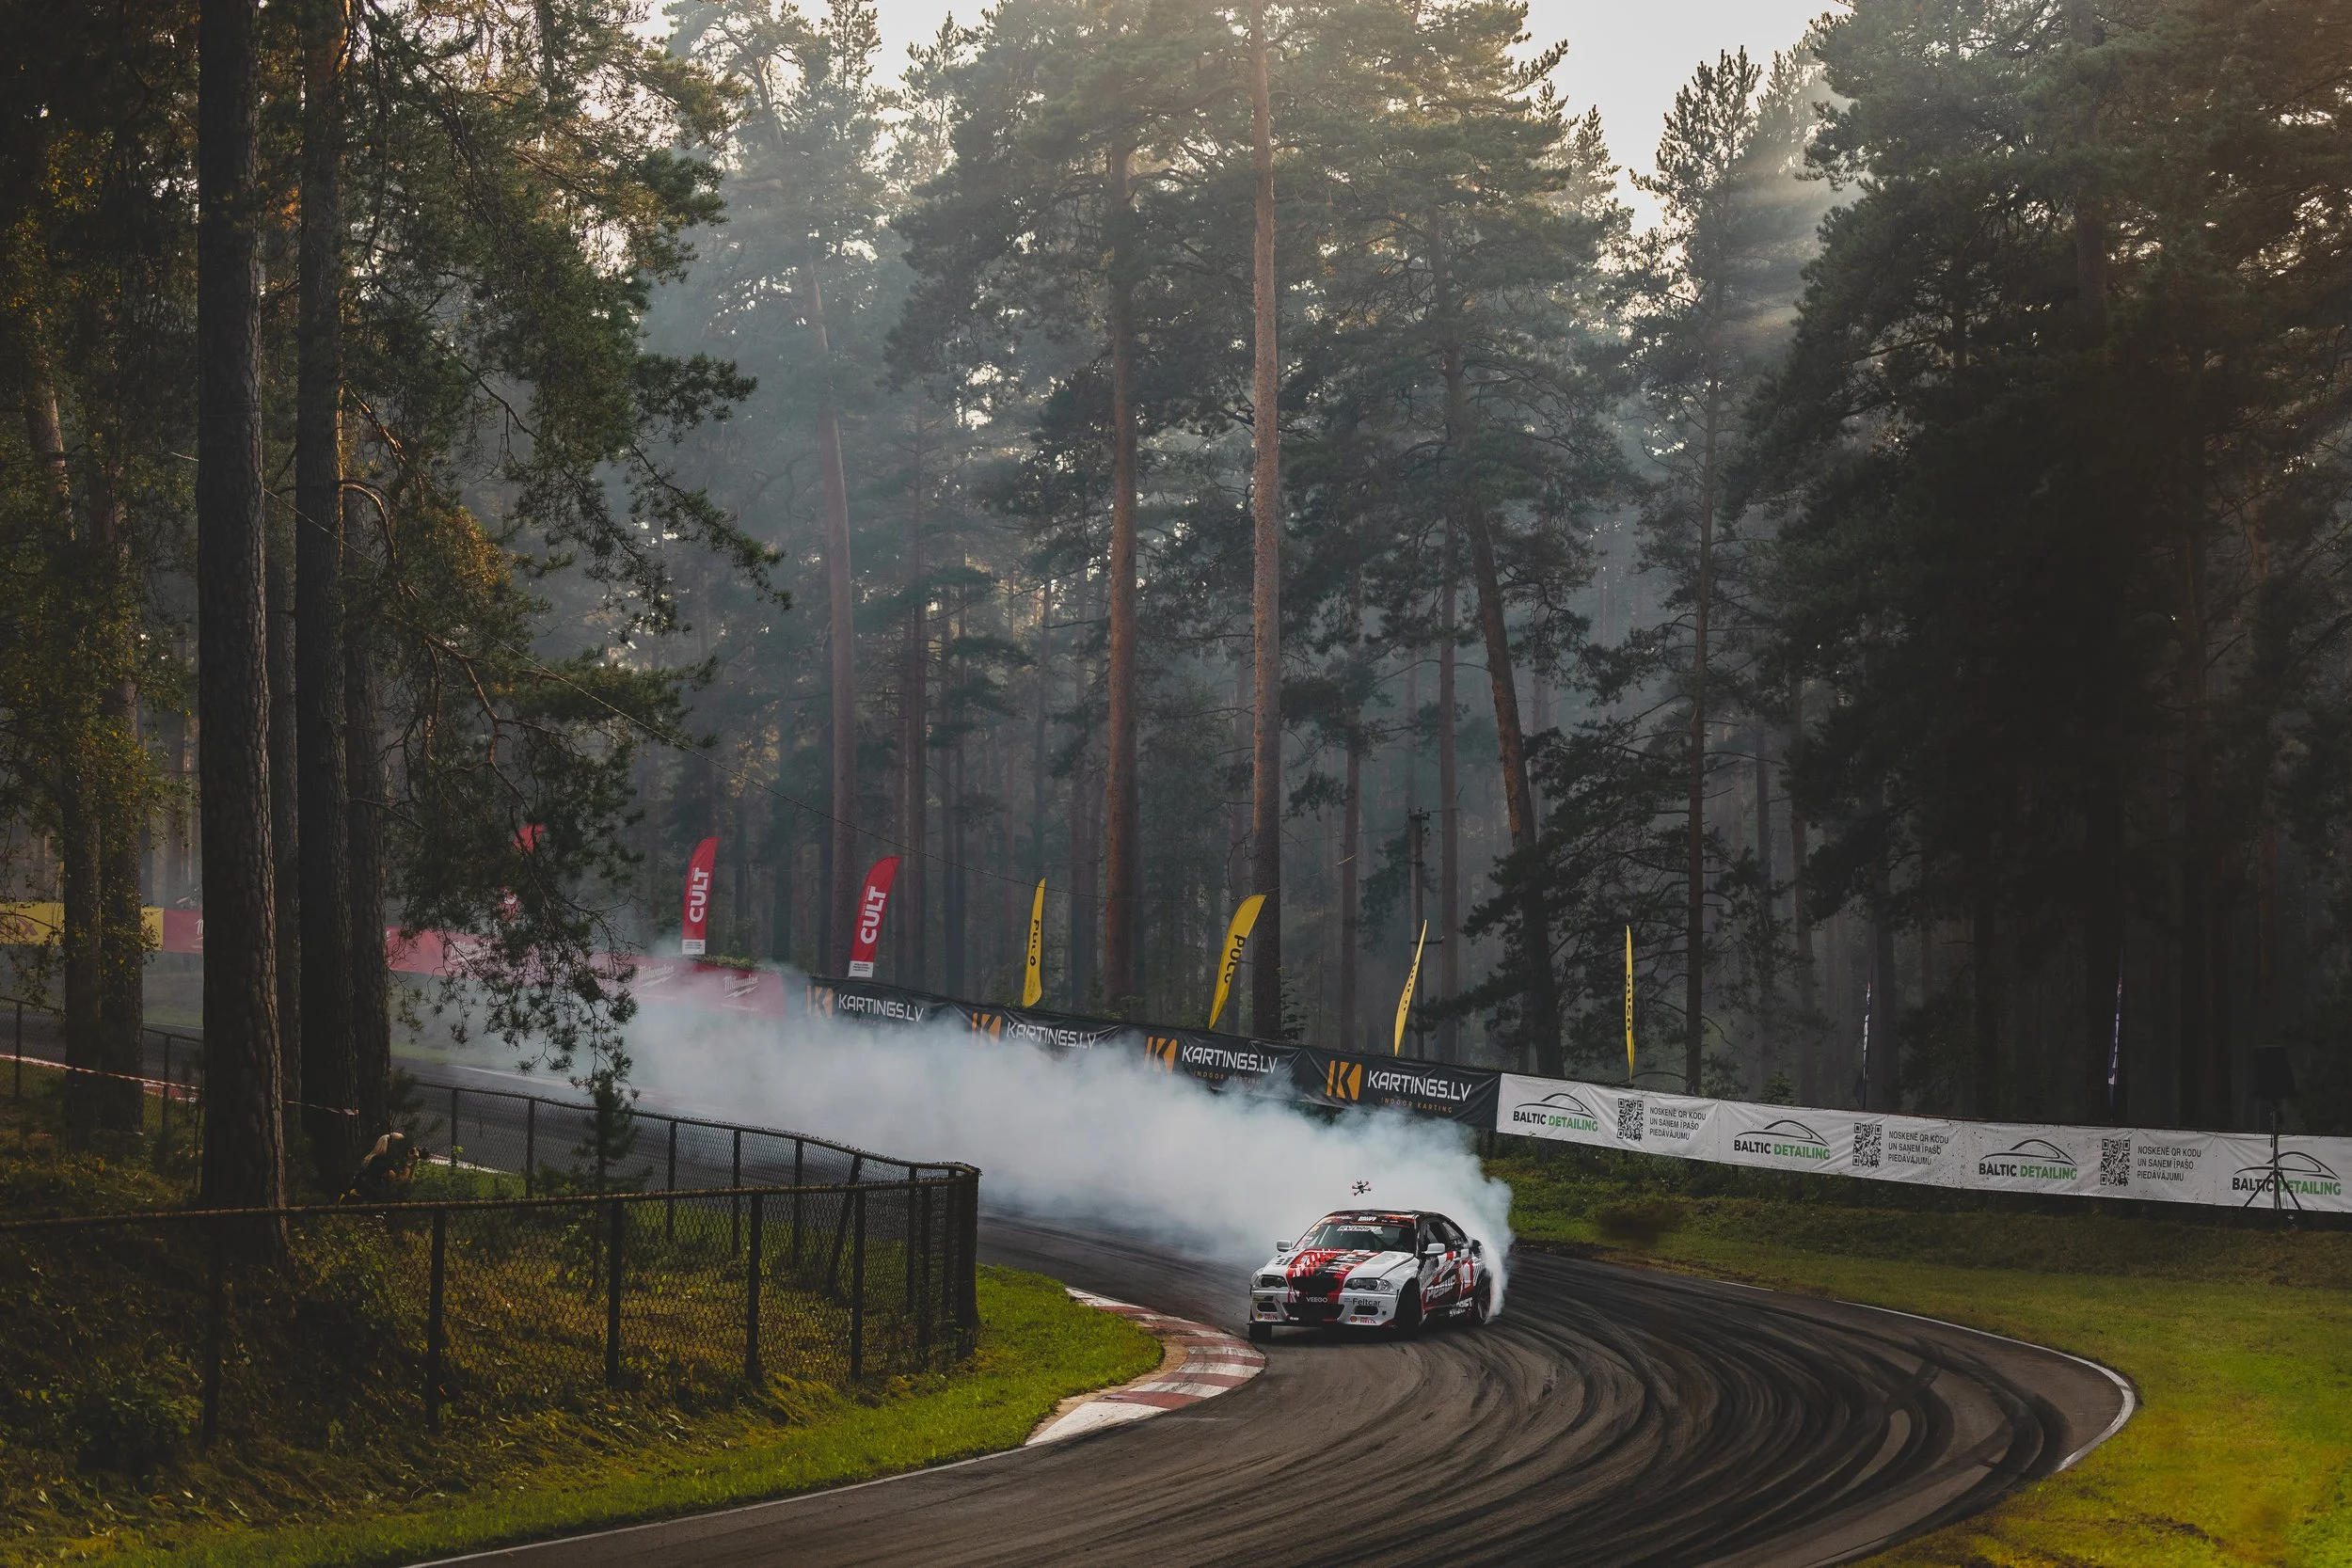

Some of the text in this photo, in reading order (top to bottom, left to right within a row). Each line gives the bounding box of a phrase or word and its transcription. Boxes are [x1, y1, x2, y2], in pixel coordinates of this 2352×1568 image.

[689, 867, 709, 923] CULT
[860, 885, 887, 944] CULT
[837, 993, 925, 1023] KARTINGS.LV
[1006, 1022, 1097, 1051] KARTINGS.LV
[1181, 1045, 1279, 1074] KARTINGS.LV
[1367, 1070, 1472, 1102] KARTINGS.LV
[1513, 1110, 1598, 1132] BALTIC DETAILING
[1677, 1110, 1688, 1118] QR
[1689, 1111, 1707, 1120] KODU
[1888, 1142, 1898, 1150] UN
[1919, 1133, 1930, 1143] QR
[1930, 1134, 1949, 1145] KODU
[1733, 1139, 1832, 1161] BALTIC DETAILING
[2137, 1145, 2201, 1158] NOSKENĒ QR KODU
[1979, 1163, 2077, 1180] BALTIC DETAILING
[2137, 1158, 2194, 1170] UN SAŅEM ĪPAŠO
[2137, 1169, 2185, 1181] PIEDĀVĀJUMU
[1352, 1298, 1381, 1307] Feltcar
